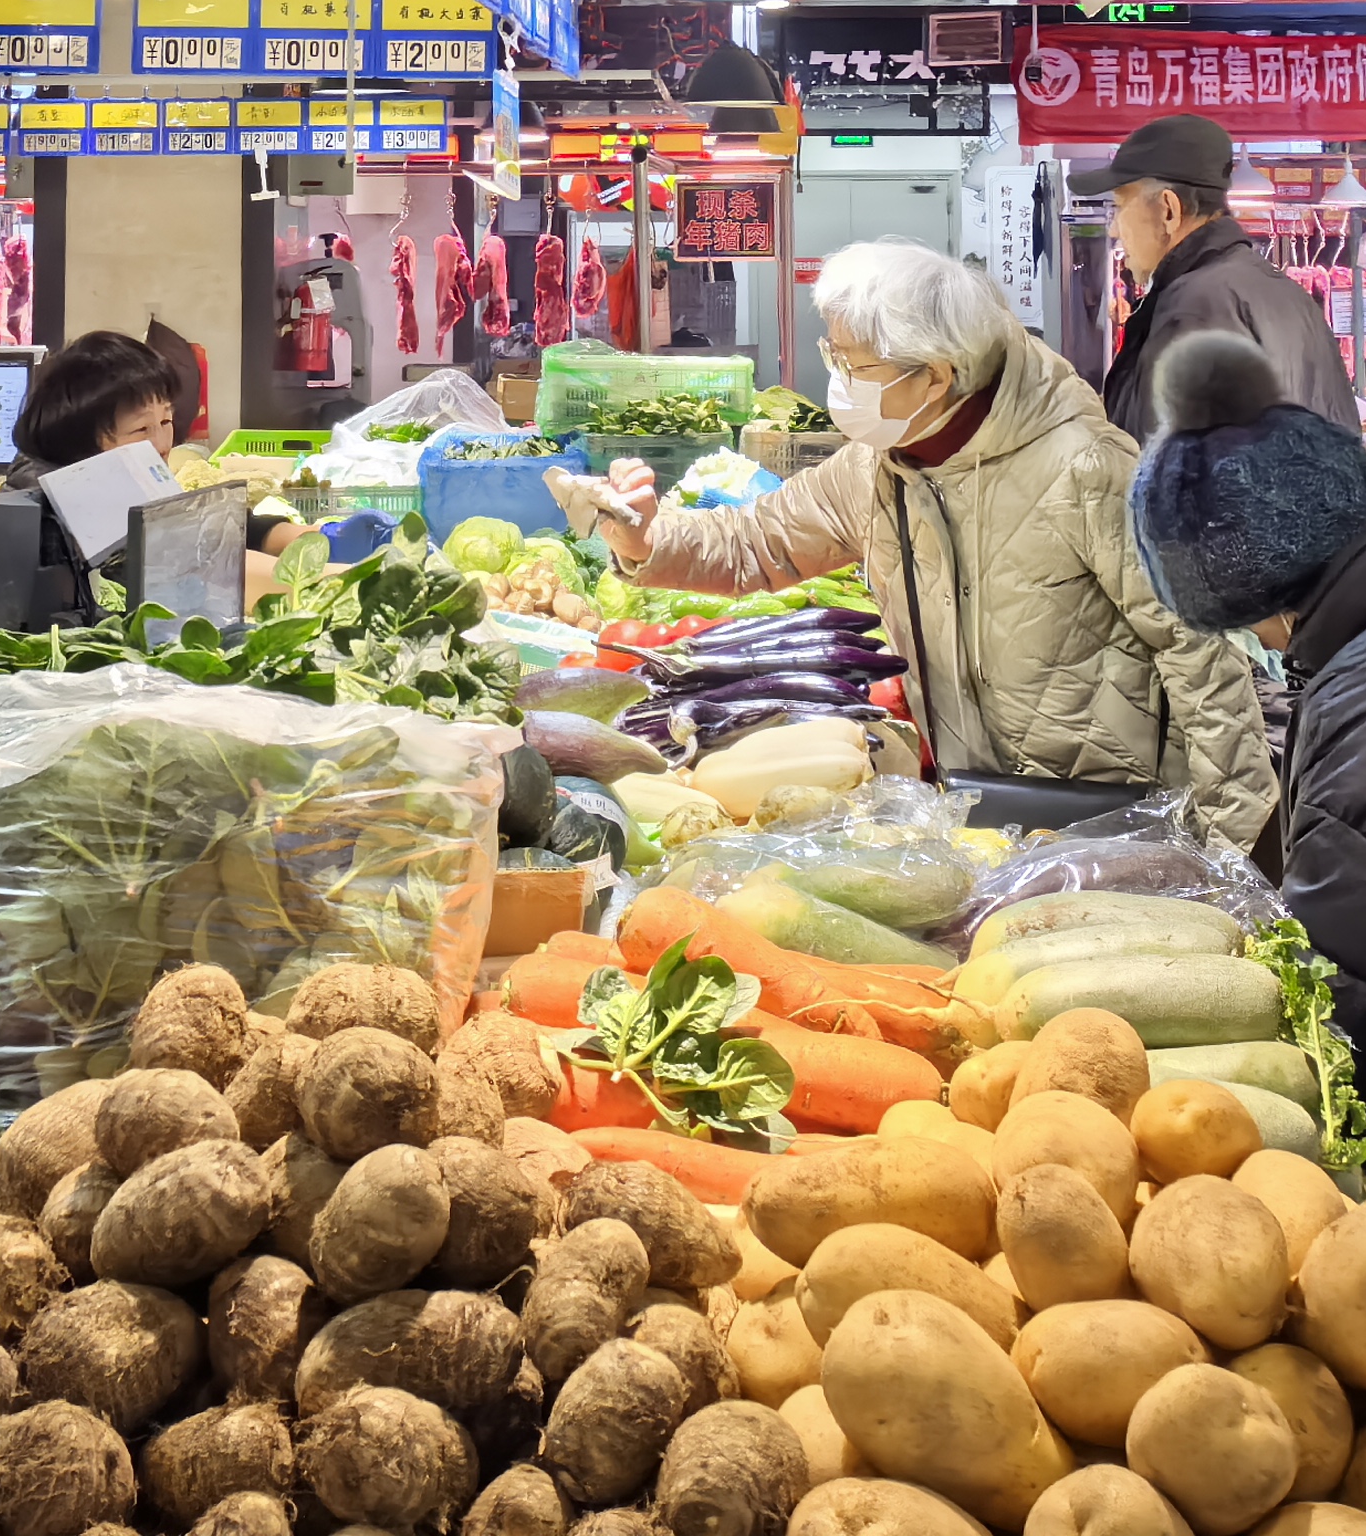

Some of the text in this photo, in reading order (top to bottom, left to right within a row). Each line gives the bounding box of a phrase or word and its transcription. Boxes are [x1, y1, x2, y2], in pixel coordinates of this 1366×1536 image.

[696, 189, 759, 219] 现杀
[684, 219, 769, 251] 年猪肉
